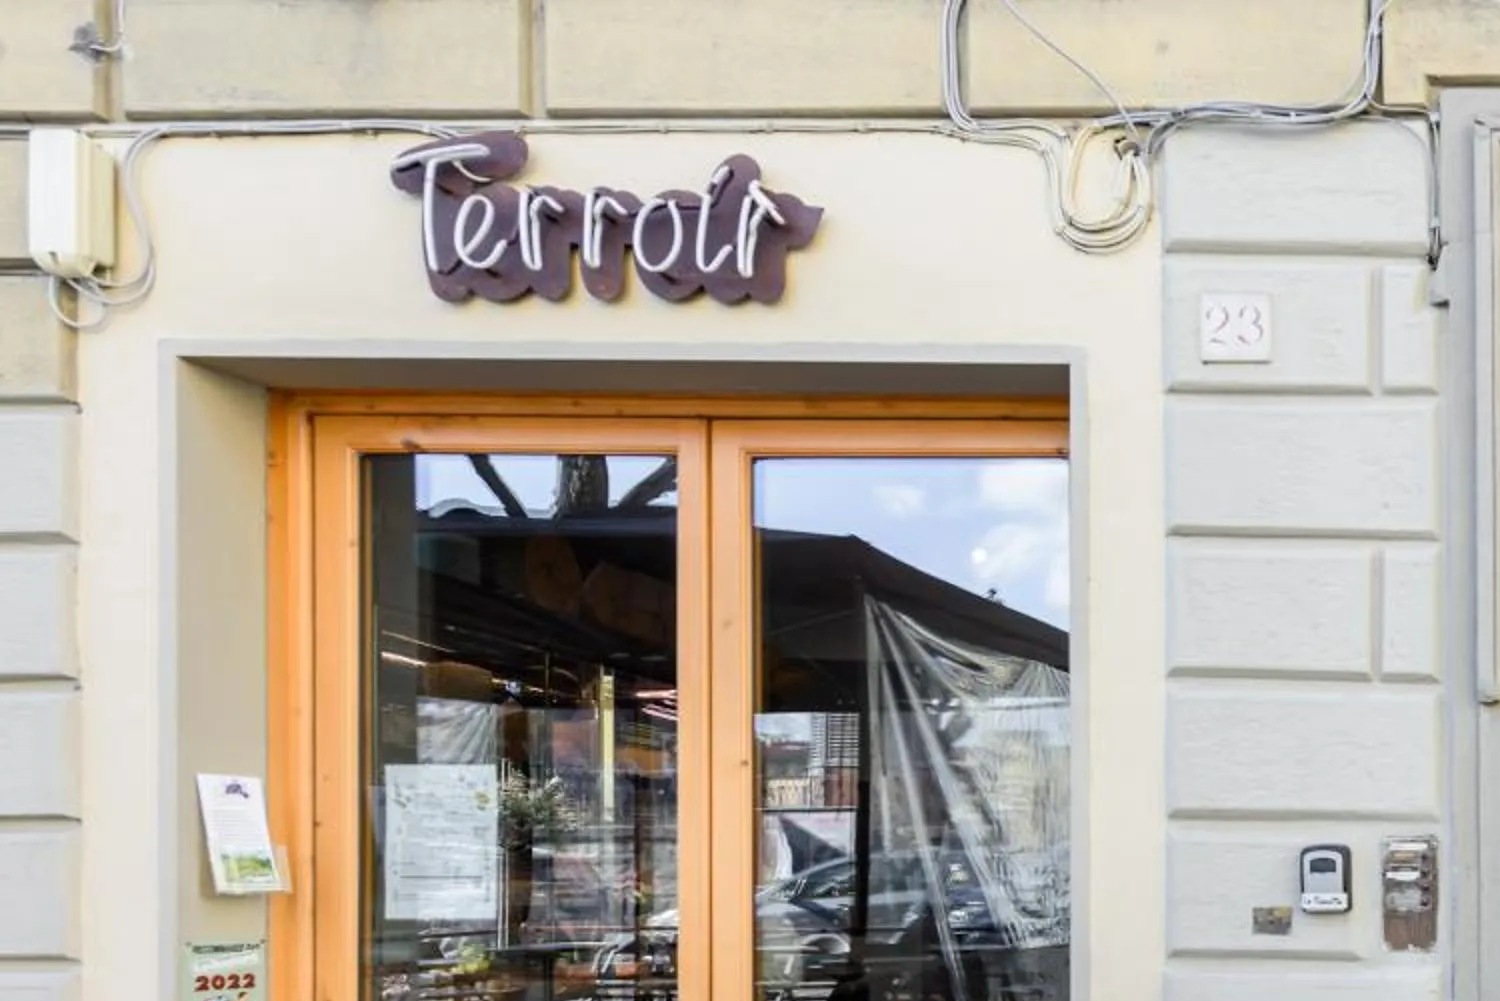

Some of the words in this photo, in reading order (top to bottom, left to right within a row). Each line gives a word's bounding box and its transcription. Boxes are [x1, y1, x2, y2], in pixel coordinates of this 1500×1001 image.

[389, 142, 787, 279] Terroir
[1204, 304, 1264, 346] 23
[194, 973, 256, 992] 2022
